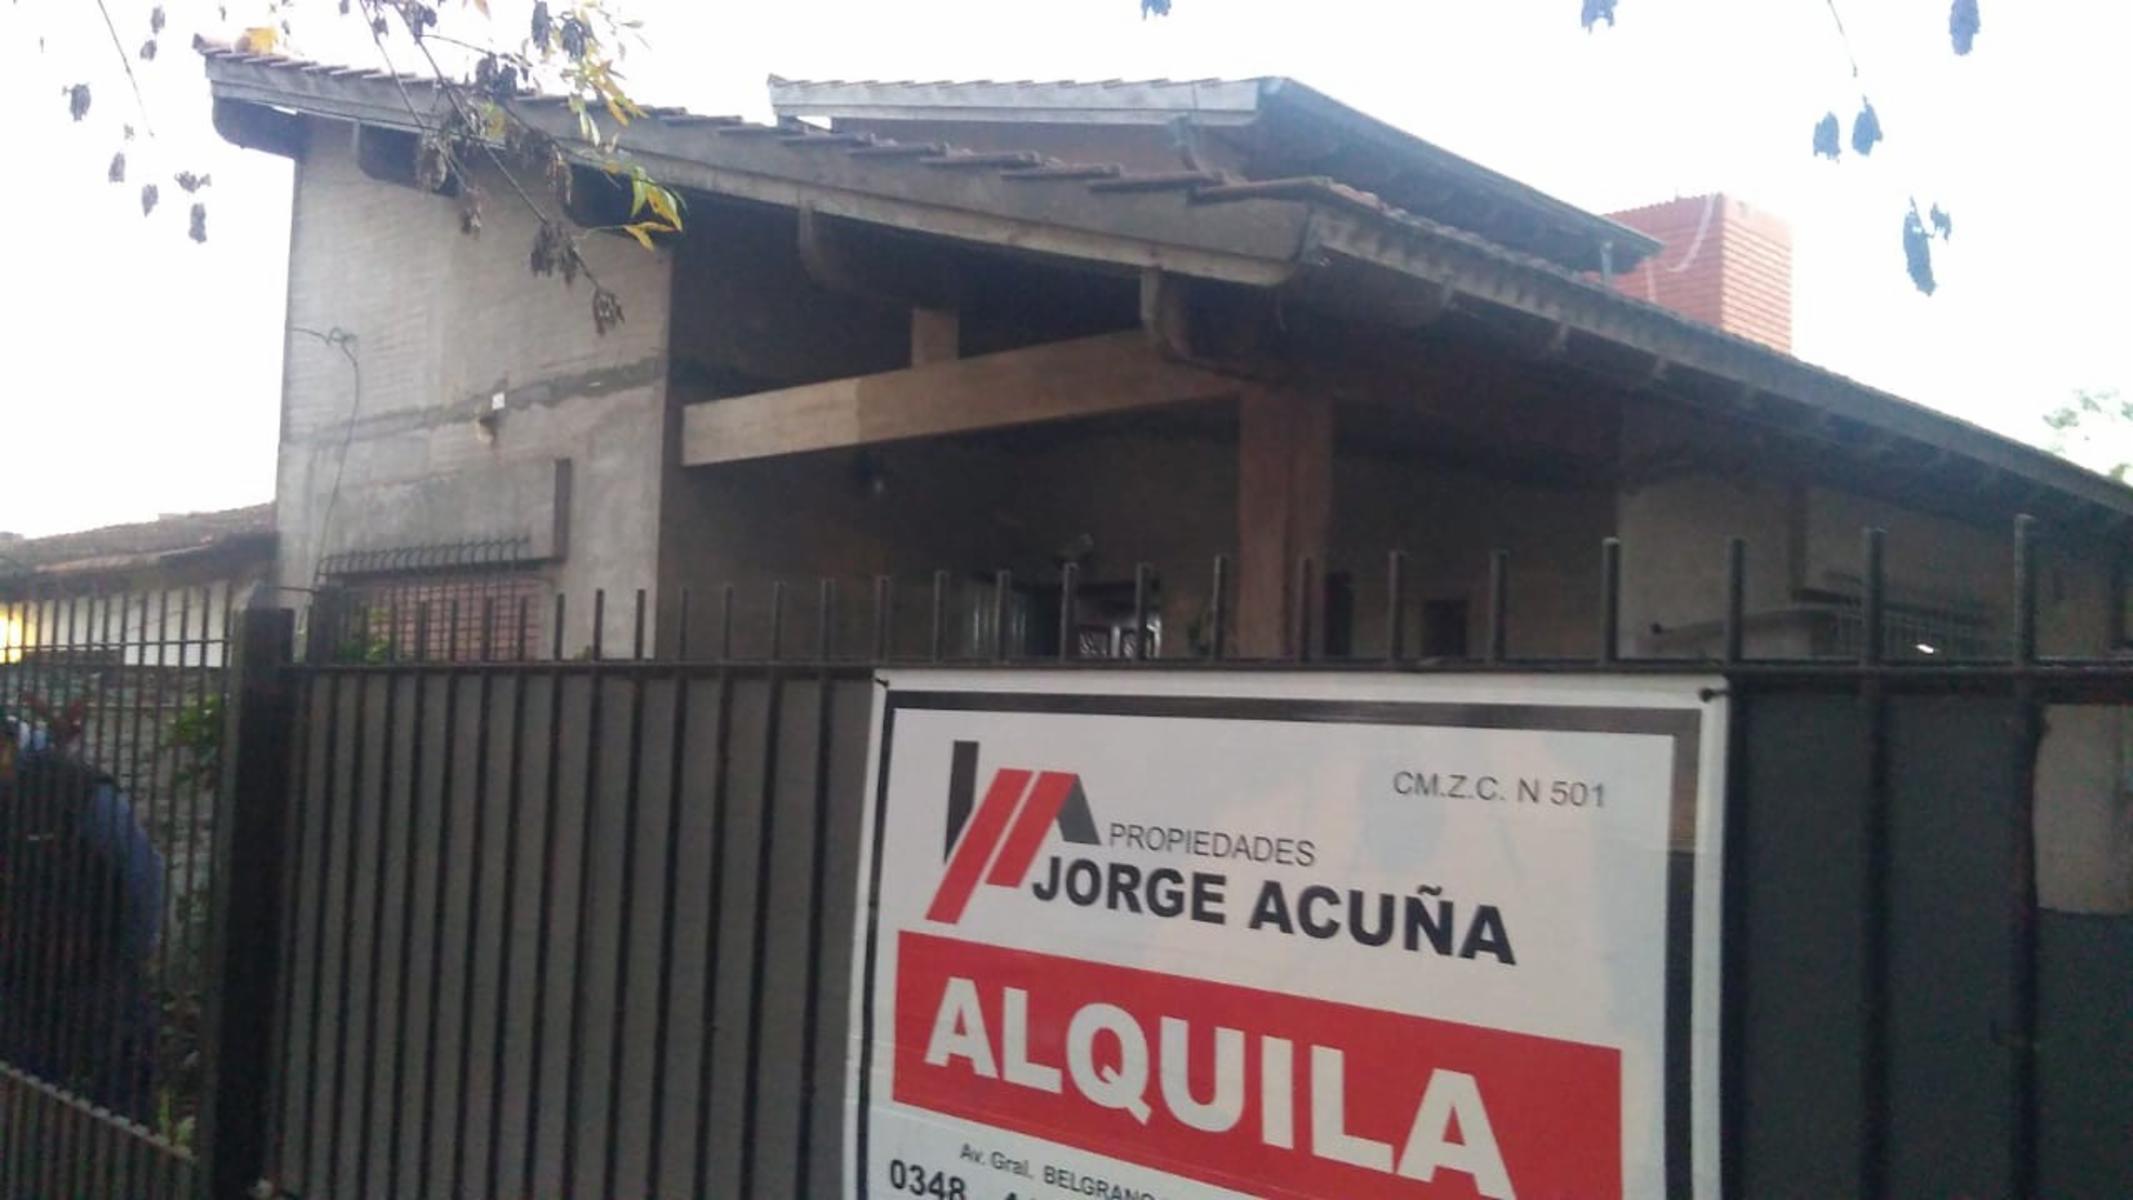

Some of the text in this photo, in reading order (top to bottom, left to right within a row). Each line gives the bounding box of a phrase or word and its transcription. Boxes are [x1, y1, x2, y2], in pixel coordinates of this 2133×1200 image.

[1517, 778, 1540, 803] N
[1550, 780, 1606, 807] 501
[1109, 823, 1316, 867] PROPIEDADES
[1032, 856, 1517, 965] JORGE ACUÑA
[924, 976, 1516, 1200] ALQUILA
[889, 1159, 966, 1200] 0348
[960, 1143, 985, 1165] Av.
[991, 1151, 1034, 1179] Gral.
